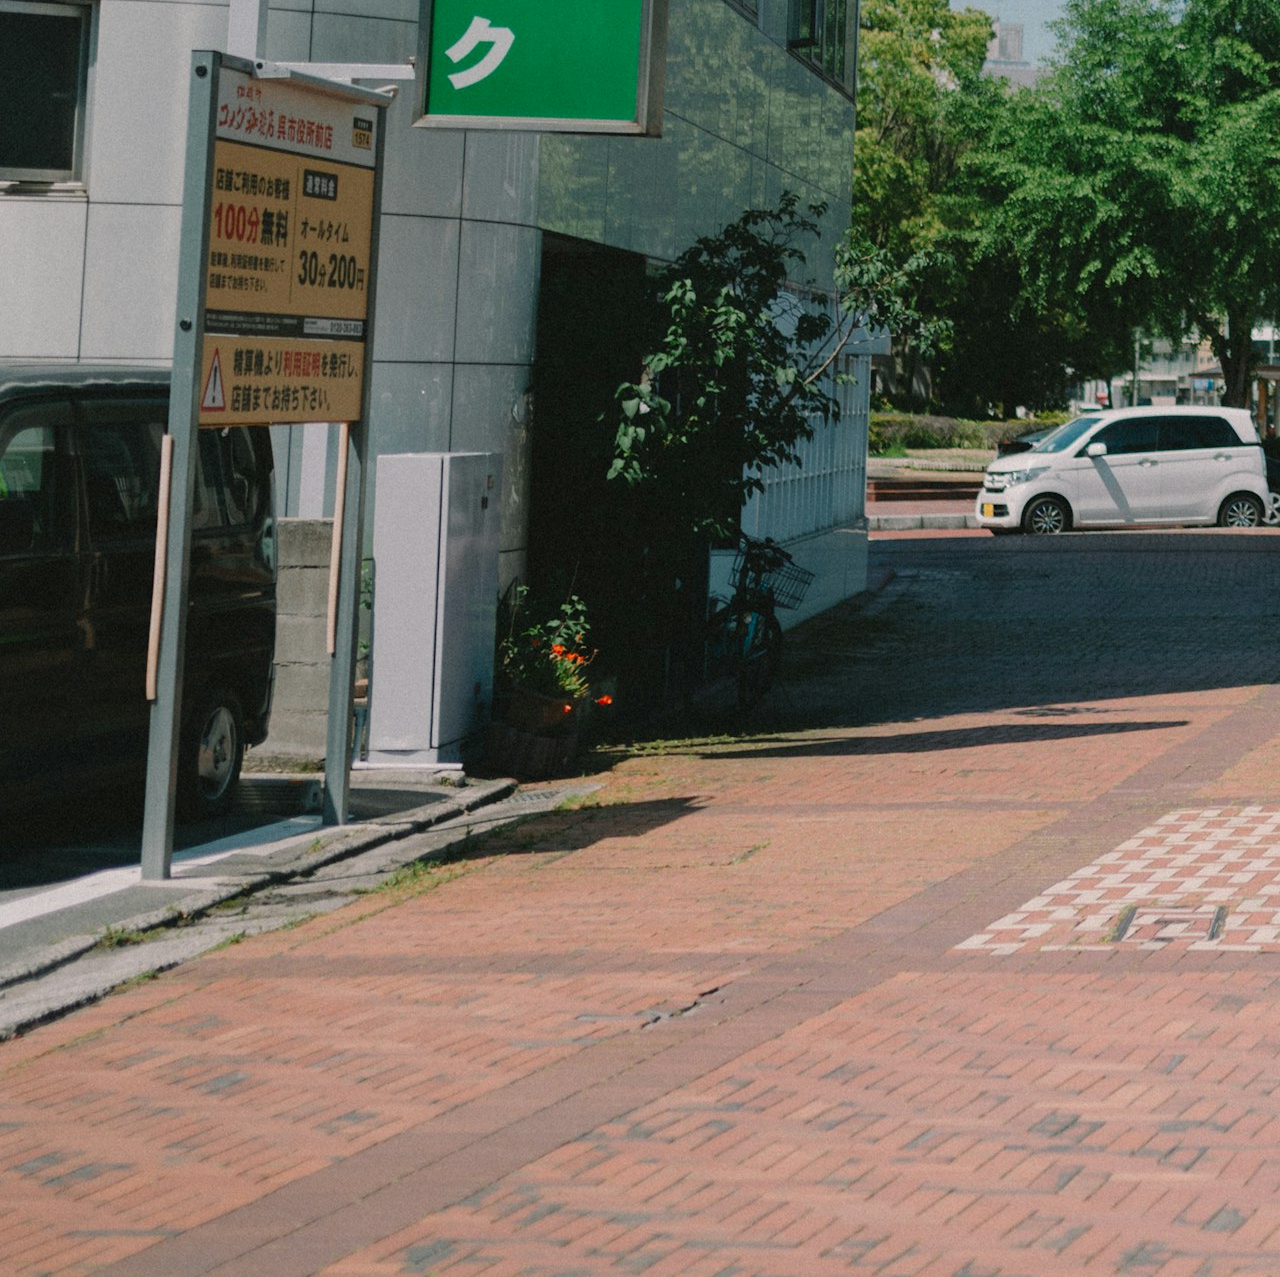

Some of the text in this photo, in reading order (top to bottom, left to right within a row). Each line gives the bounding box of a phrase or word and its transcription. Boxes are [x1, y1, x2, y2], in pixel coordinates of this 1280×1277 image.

[301, 217, 349, 243] オールタイム
[231, 384, 331, 412] 店舗までお持ち下さい。
